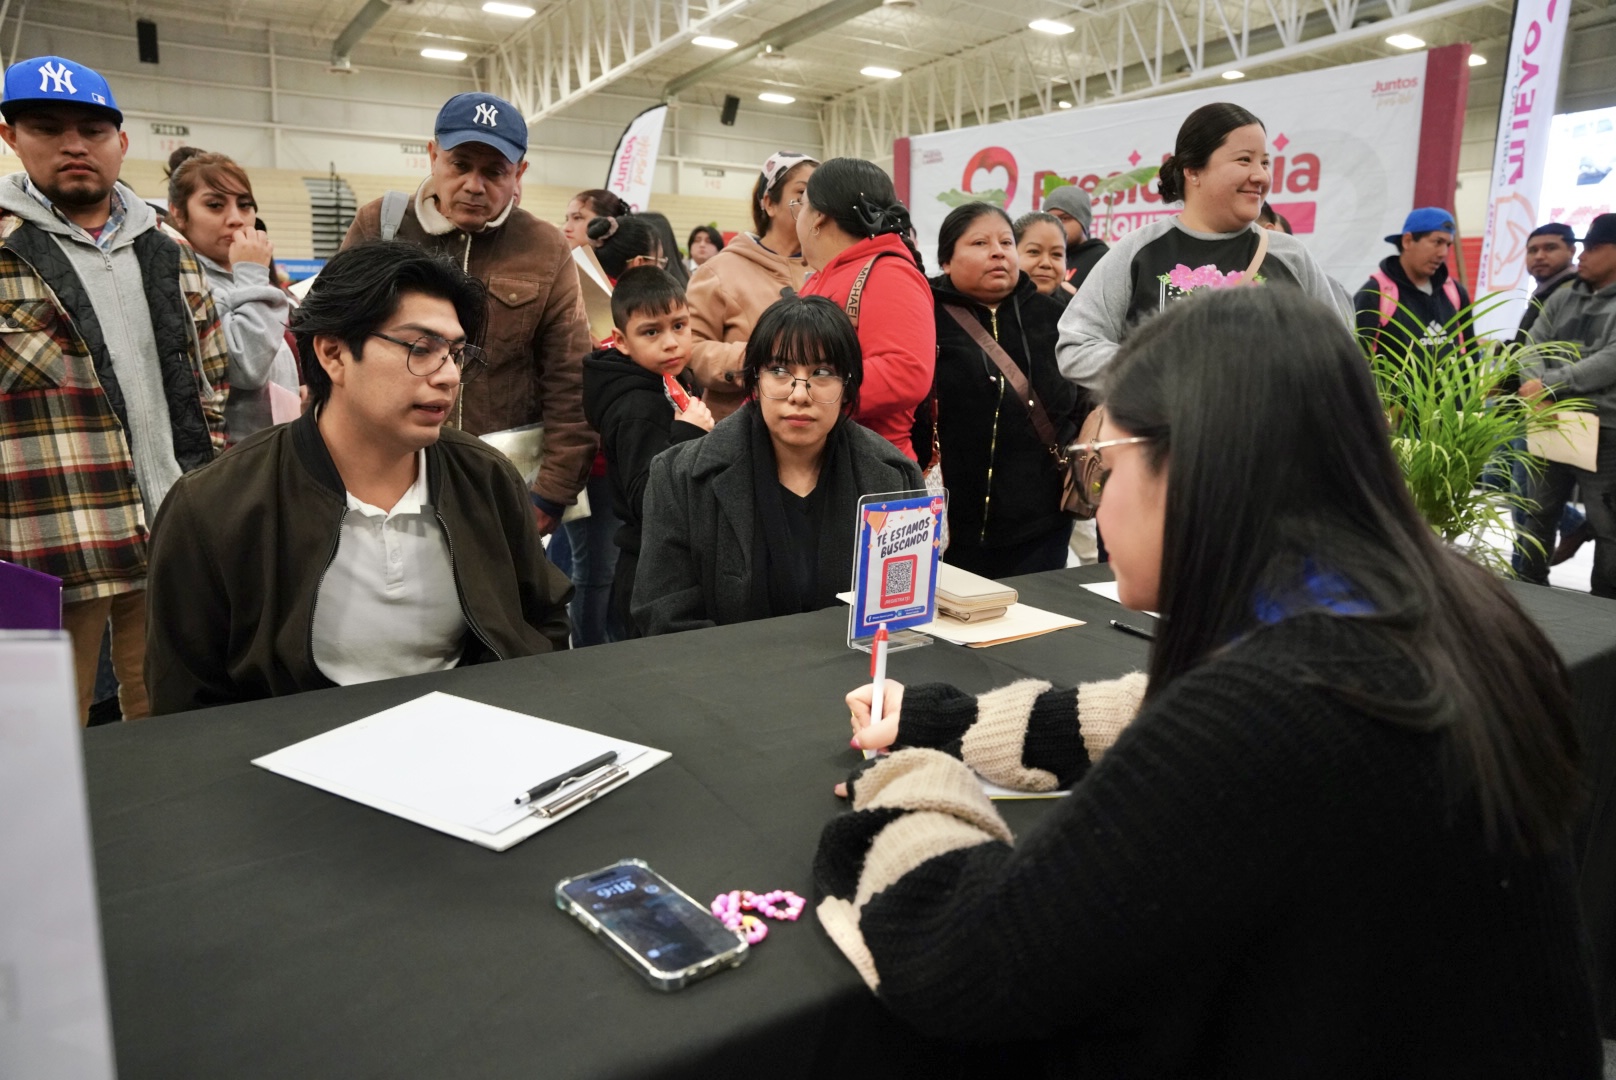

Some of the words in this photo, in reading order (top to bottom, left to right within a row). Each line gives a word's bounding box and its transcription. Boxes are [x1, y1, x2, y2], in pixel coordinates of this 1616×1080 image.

[38, 61, 78, 95] NY
[1371, 76, 1419, 93] Juntos
[472, 102, 499, 127] NY
[613, 135, 638, 192] Juntos
[877, 532, 888, 547] TE
[890, 516, 931, 541] ESTAMOS
[880, 530, 929, 558] BUSCANDO
